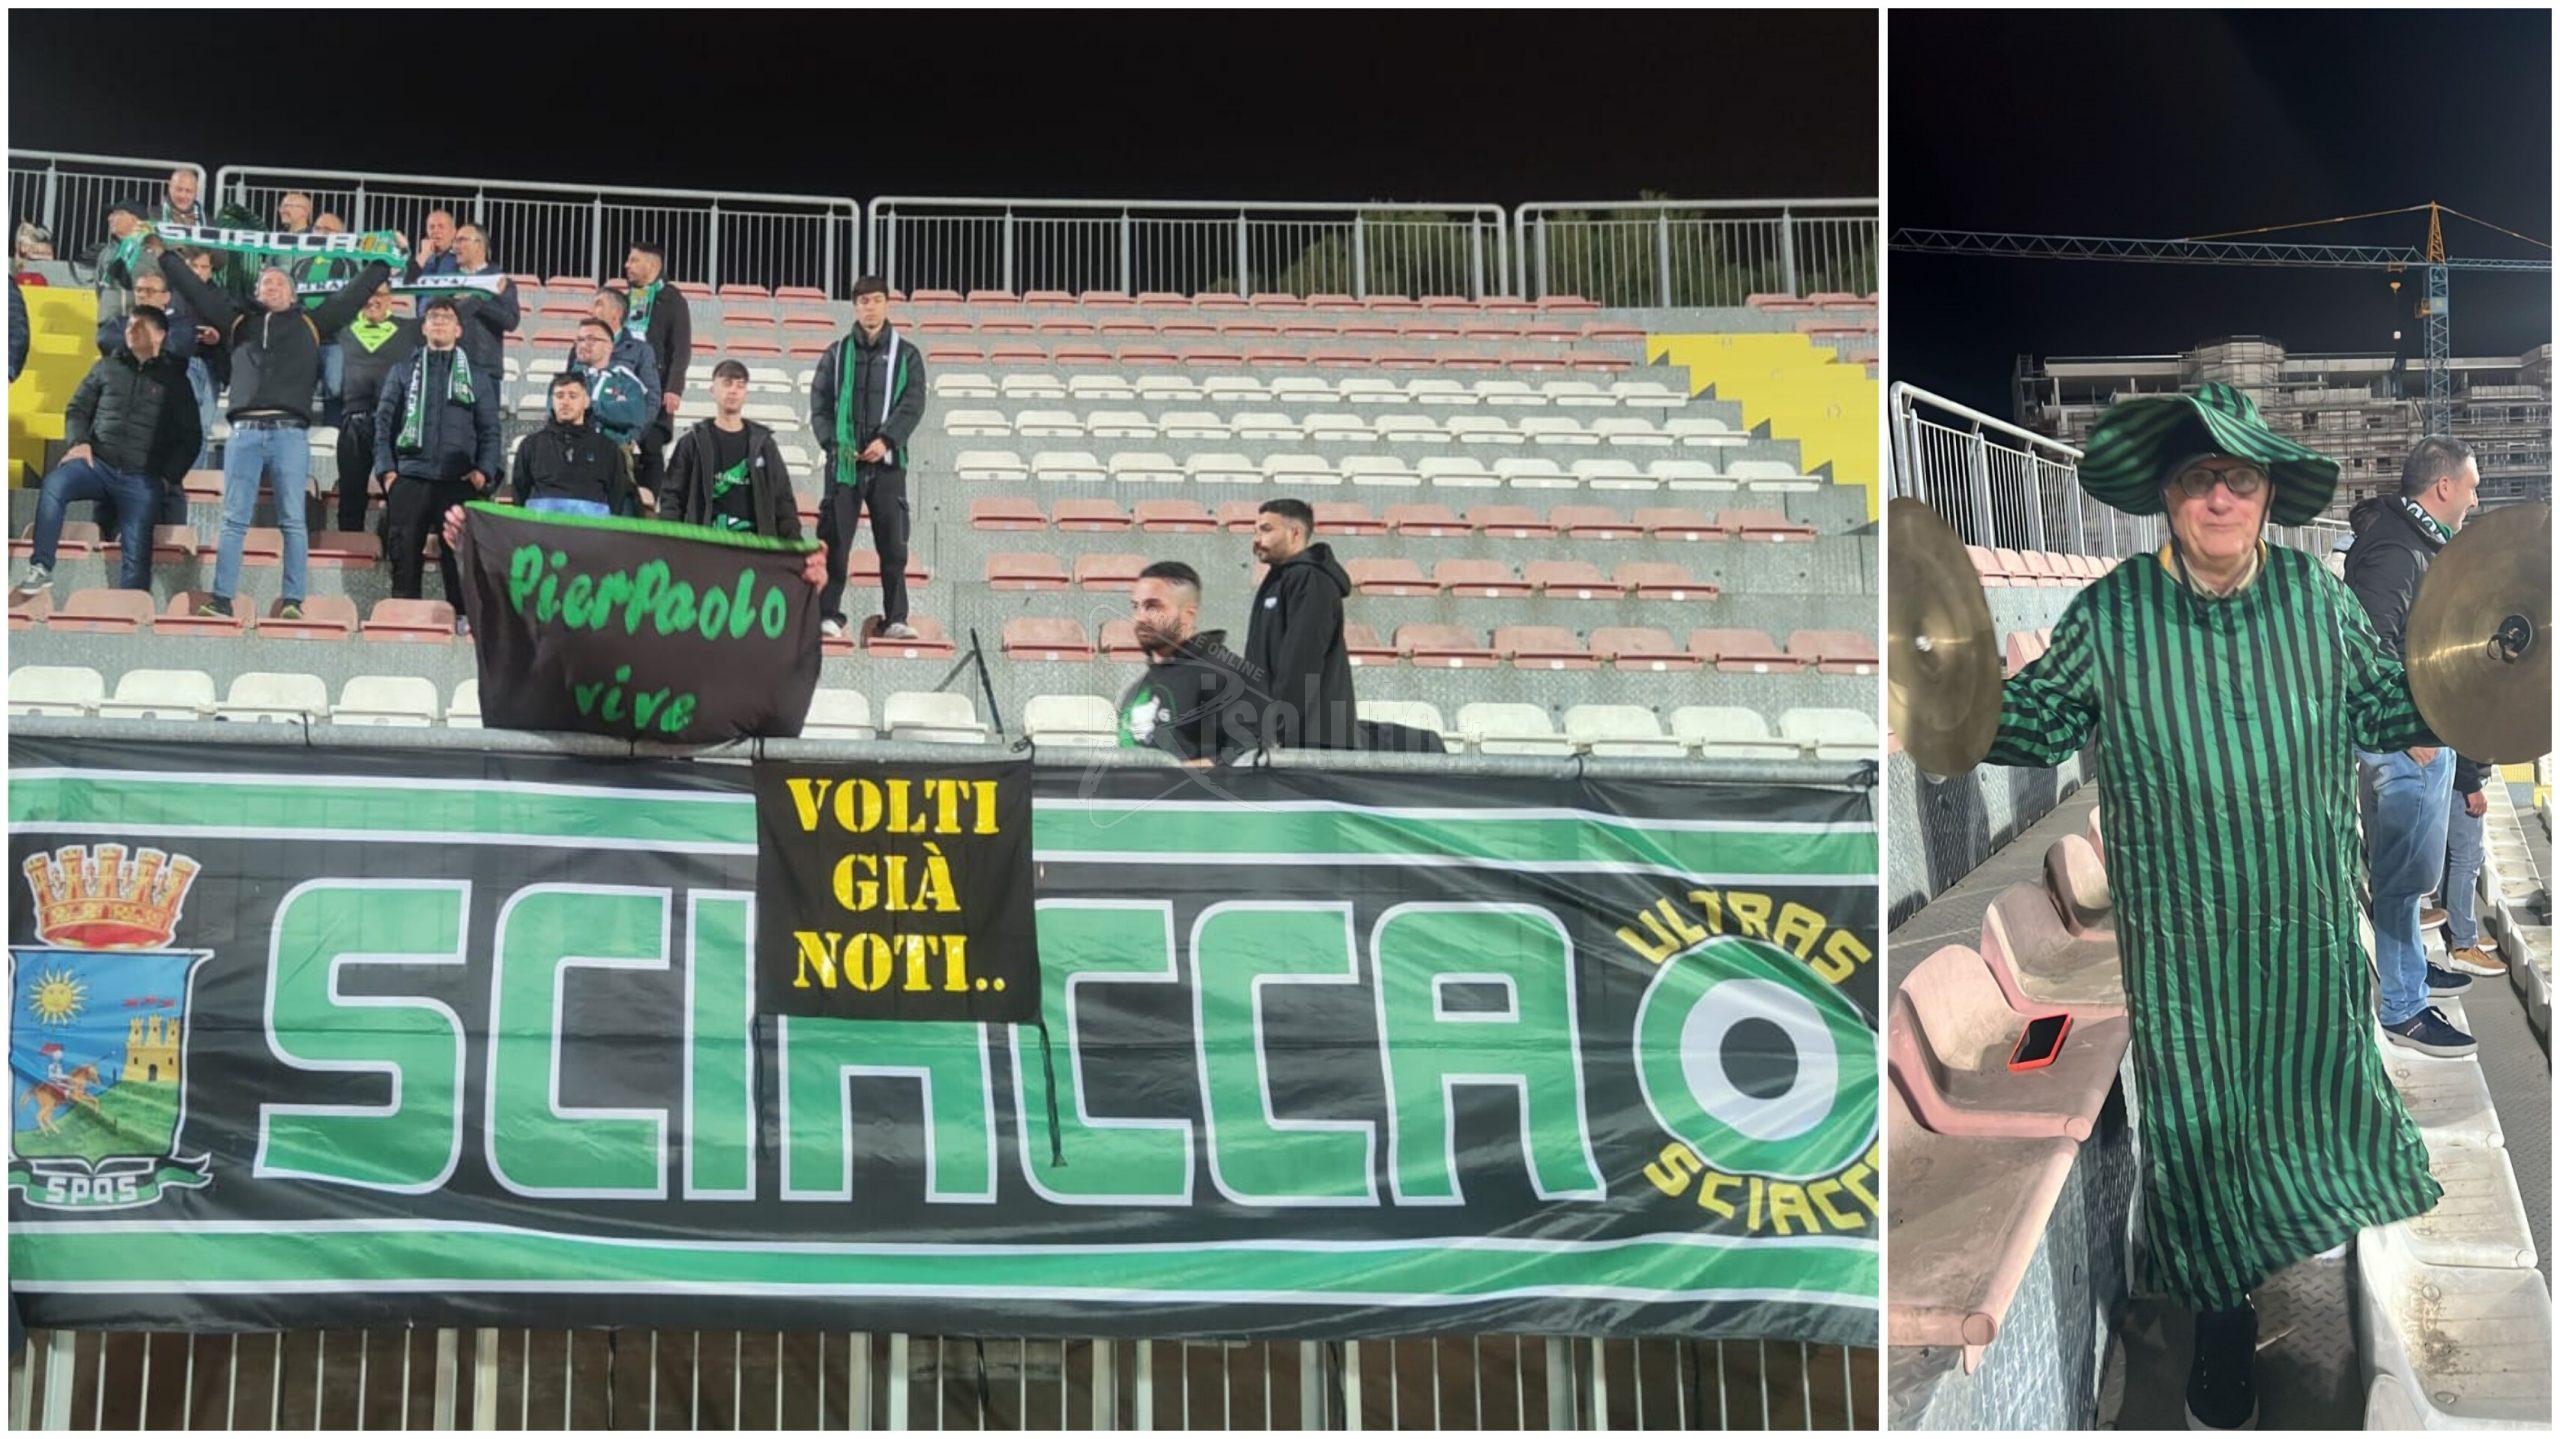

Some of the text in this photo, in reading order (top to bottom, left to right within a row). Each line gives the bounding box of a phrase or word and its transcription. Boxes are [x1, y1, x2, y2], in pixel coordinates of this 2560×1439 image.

[156, 222, 358, 253] SCIACCA
[509, 544, 786, 640] PierPaolo
[575, 664, 697, 732] vive
[785, 779, 1000, 834] VOLTI
[832, 842, 961, 911] GIÀ
[793, 931, 1006, 992] NOTI..
[1615, 890, 1873, 985] ULTRAS
[1643, 1142, 1879, 1235] SCIACC
